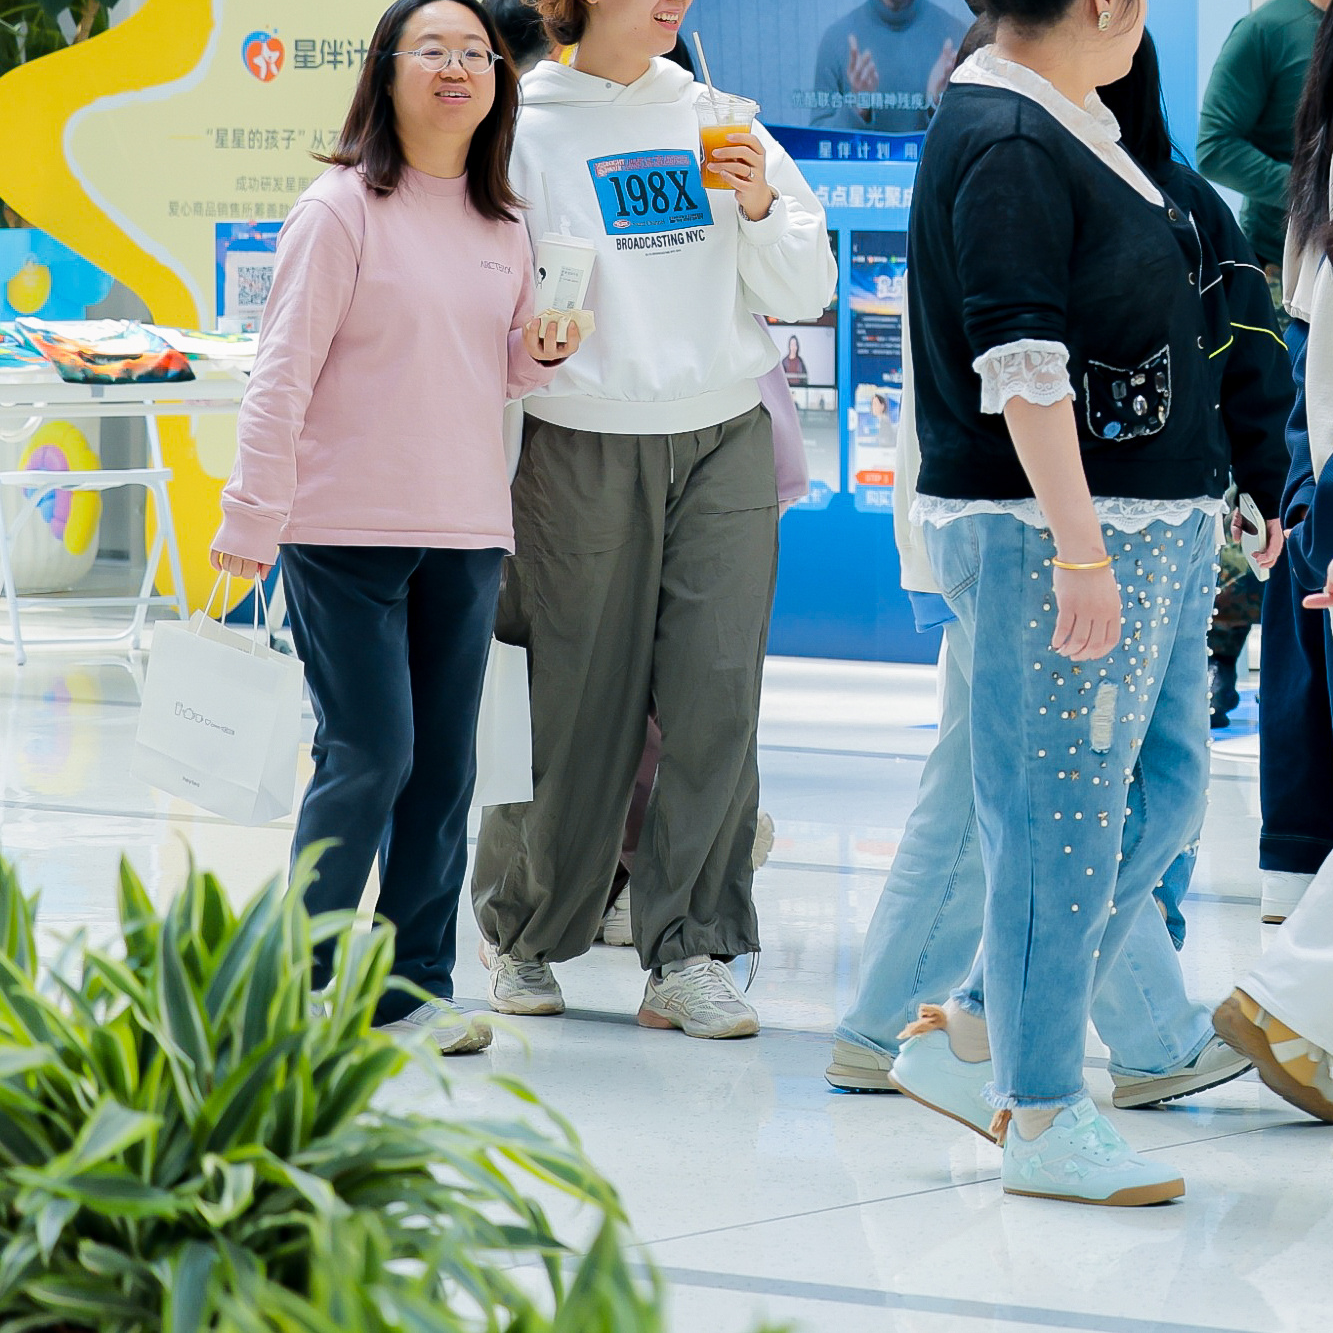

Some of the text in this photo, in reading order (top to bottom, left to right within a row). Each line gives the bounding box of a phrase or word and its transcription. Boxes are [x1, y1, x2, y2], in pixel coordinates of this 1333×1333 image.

[608, 170, 699, 217] 198X
[616, 229, 706, 251] BROADCASTING NYC
